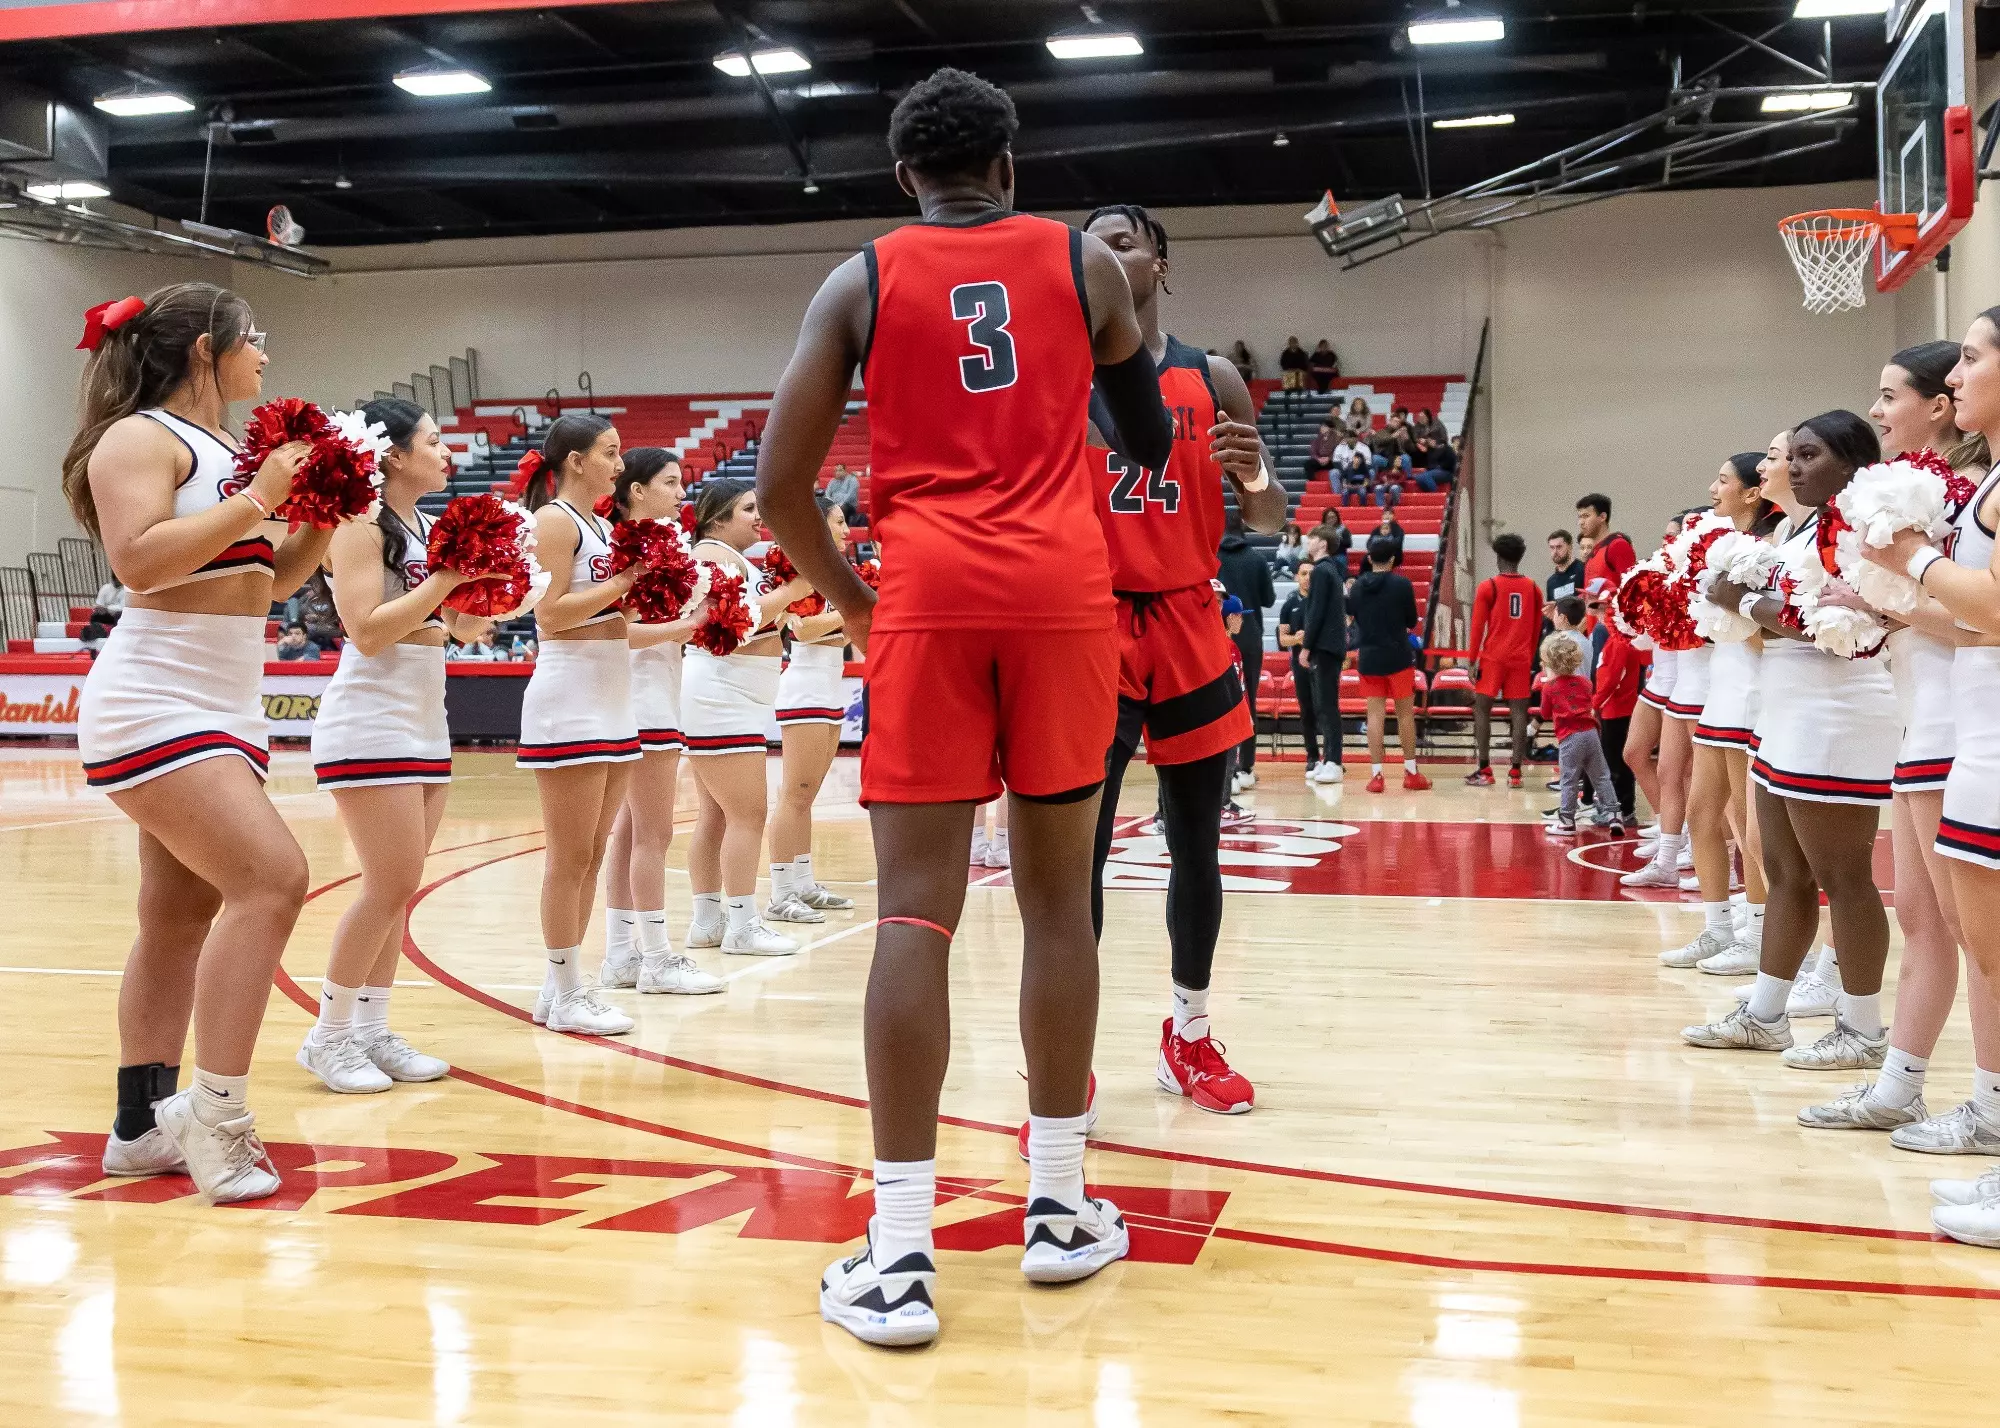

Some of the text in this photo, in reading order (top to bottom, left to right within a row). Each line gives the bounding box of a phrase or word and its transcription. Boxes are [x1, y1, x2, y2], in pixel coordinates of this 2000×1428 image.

[950, 281, 1018, 393] 3
[1173, 405, 1197, 441] TE
[1107, 452, 1180, 513] 24
[1509, 593, 1522, 619] 0
